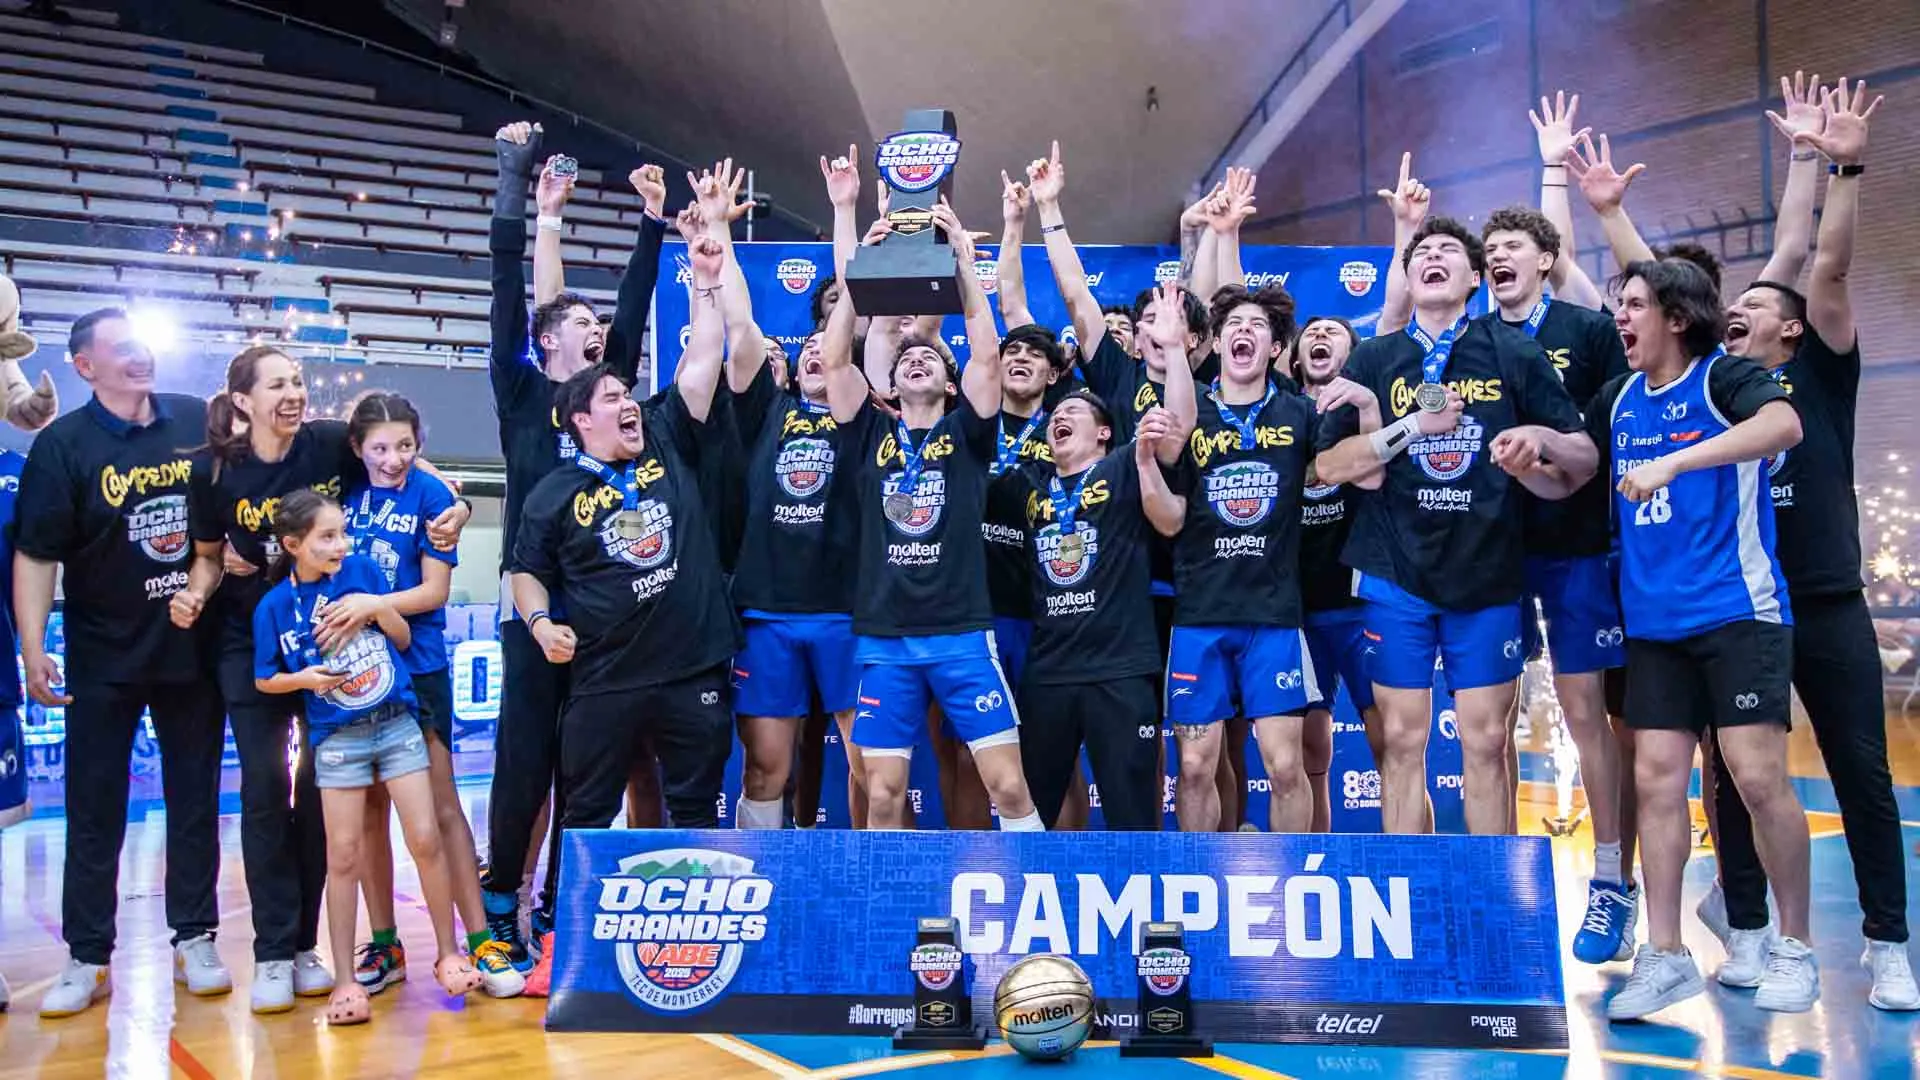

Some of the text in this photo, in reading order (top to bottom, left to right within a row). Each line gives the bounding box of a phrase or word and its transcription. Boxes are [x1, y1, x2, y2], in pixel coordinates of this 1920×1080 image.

[880, 142, 959, 156] OCHO
[878, 155, 956, 167] GRANDES
[777, 265, 816, 273] OCHO
[1191, 426, 1295, 467] CAMPENES
[1408, 440, 1481, 455] GRANDES
[779, 449, 835, 464] OCHO
[101, 459, 193, 507] CAMPEONE
[1207, 472, 1278, 490] OCHO
[1208, 487, 1278, 501] GRANDES
[1417, 488, 1472, 503] molten
[775, 502, 825, 517] molten
[1635, 486, 1672, 526] 28
[128, 504, 188, 529] OCH
[981, 522, 1025, 541] molten
[888, 541, 942, 557] molten
[1046, 590, 1096, 608] molten
[600, 878, 774, 912] OCHO
[951, 854, 1414, 960] CAMPEÓN
[593, 914, 768, 941] GRANDES
[654, 943, 722, 967] ABE
[911, 951, 962, 963] OCHO
[1138, 956, 1191, 967] OCHO
[1138, 966, 1190, 976] GRANDES
[630, 974, 725, 1006] TEC DE MONTERREY
[848, 1003, 916, 1028] #Borregos
[1014, 1003, 1074, 1027] molten
[1316, 1013, 1383, 1035] telcel
[1471, 1016, 1517, 1027] POWER
[1492, 1027, 1519, 1037] ADE
